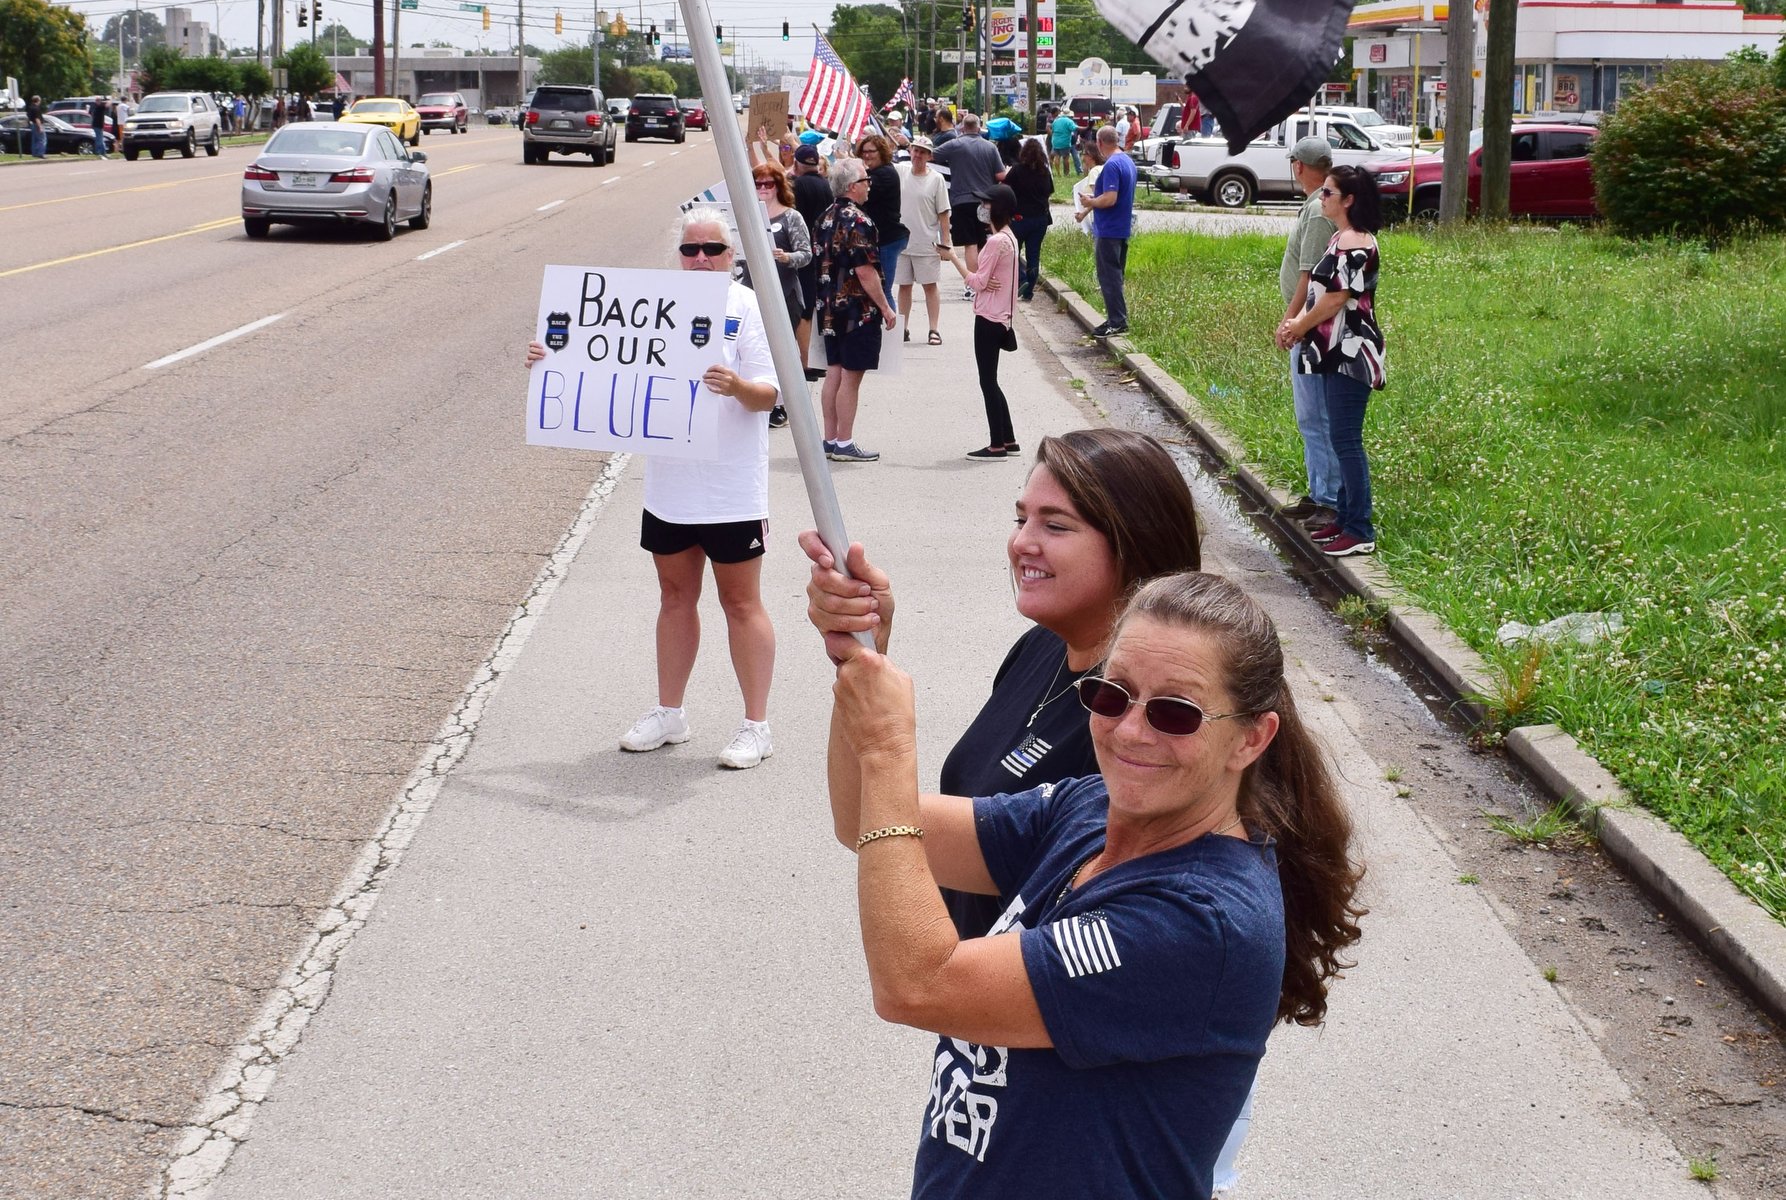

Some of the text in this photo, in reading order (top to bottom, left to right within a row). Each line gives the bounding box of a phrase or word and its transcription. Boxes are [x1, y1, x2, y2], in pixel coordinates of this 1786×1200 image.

[578, 272, 676, 330] BACK
[587, 334, 666, 367] OUR
[540, 370, 700, 443] BLUE!
